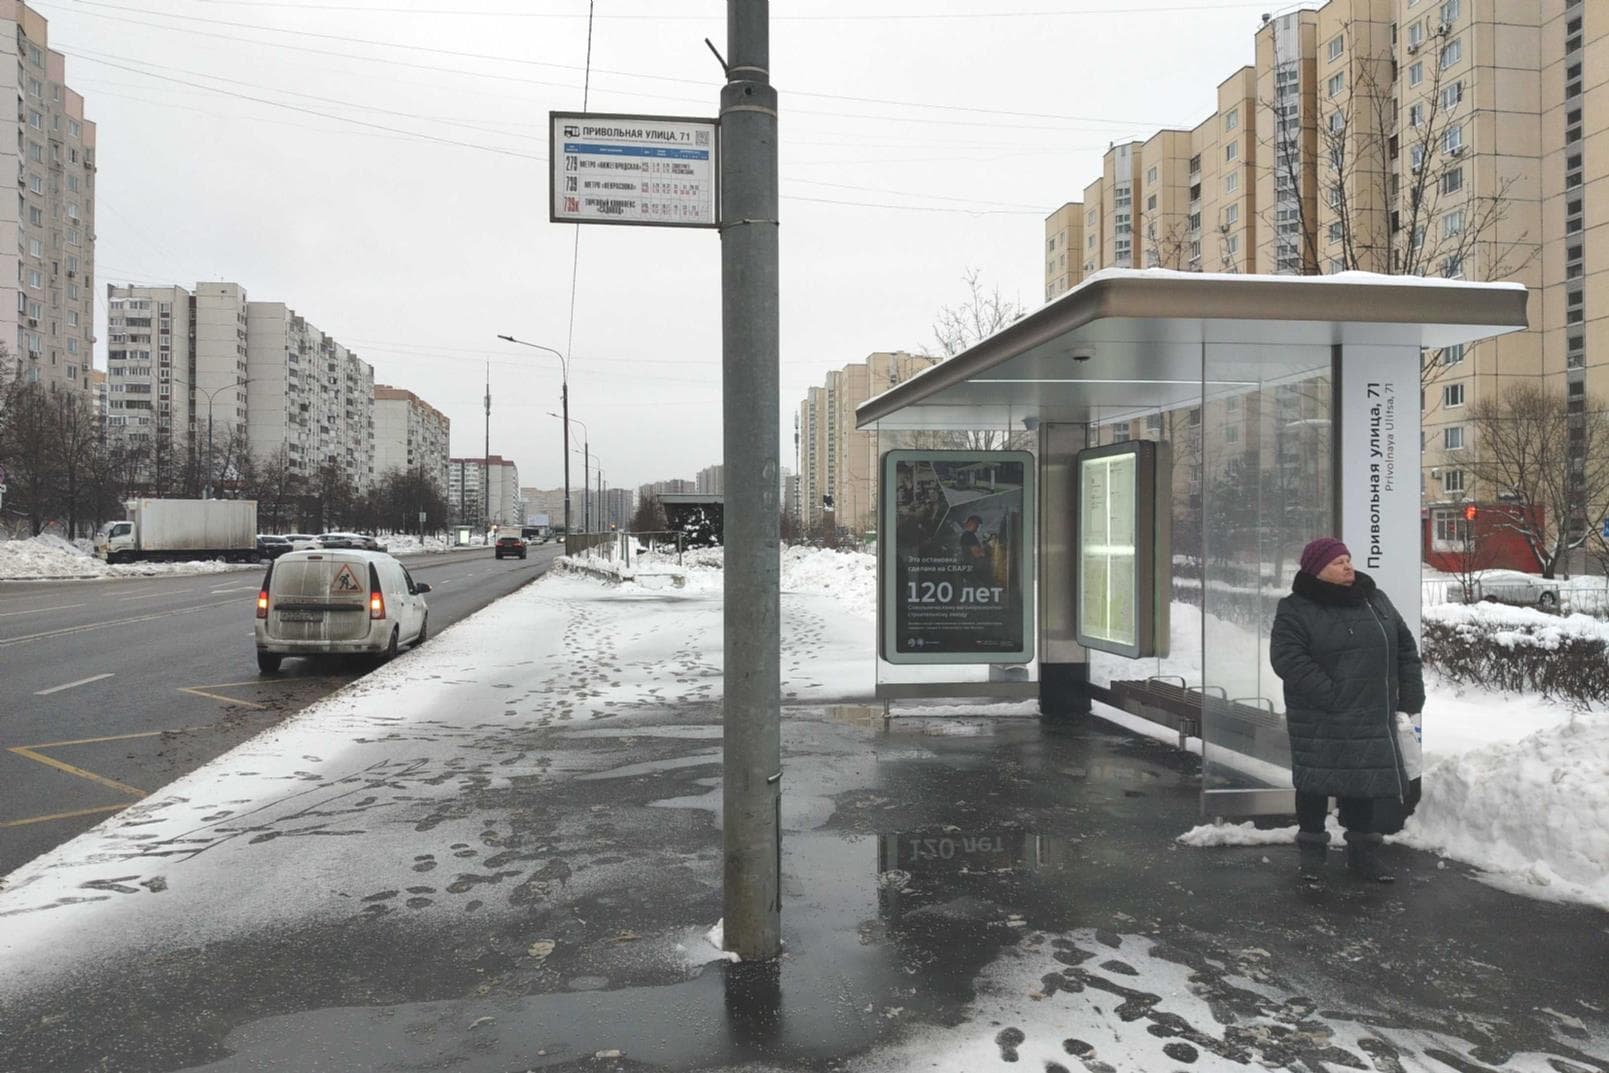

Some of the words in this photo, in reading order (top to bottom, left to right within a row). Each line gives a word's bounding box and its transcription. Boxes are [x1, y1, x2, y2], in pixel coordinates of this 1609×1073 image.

[582, 126, 643, 138] ПРИВОЛЬНАЯ
[645, 128, 677, 141] УЛИЦА,
[680, 131, 690, 141] 71
[566, 155, 578, 171] 279
[584, 181, 601, 189] МЕТРО
[1367, 382, 1380, 399] 71
[1385, 382, 1394, 393] 71
[1385, 395, 1396, 431] Ulitsa,
[1370, 403, 1383, 459] улица,
[1385, 433, 1395, 492] Privolnaya
[1367, 463, 1382, 569] Привольная
[907, 581, 953, 603] 120
[959, 587, 1003, 603] лет
